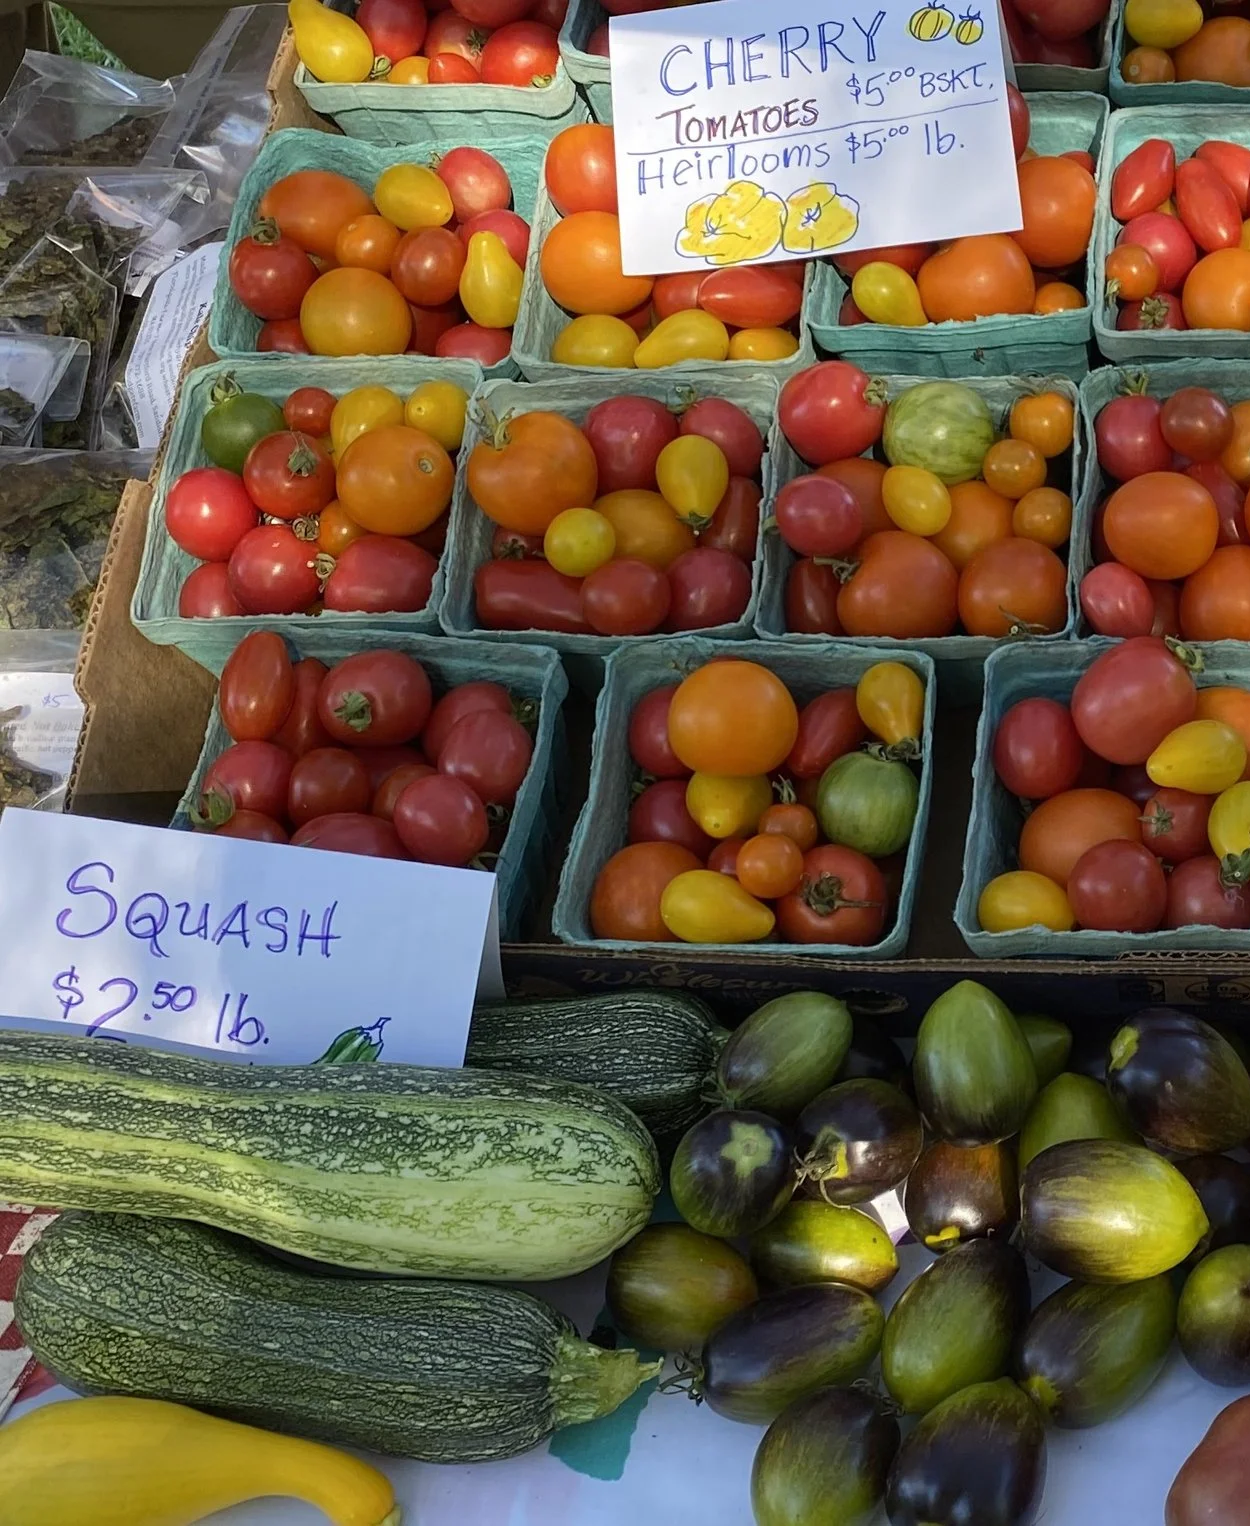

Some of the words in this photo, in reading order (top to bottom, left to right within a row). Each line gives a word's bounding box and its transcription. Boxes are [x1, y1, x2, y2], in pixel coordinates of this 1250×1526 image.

[659, 11, 887, 97] CHERRY
[845, 66, 916, 108] $5.00
[919, 62, 996, 99] BSKT.
[637, 140, 831, 196] Heirlooms
[848, 124, 910, 165] $5.00
[925, 121, 966, 157] lb.
[655, 99, 820, 147] TOMATOES
[41, 692, 70, 708] $5
[55, 861, 342, 959] SQUASH
[52, 965, 198, 1043] $2.50
[213, 992, 271, 1046] lb.
